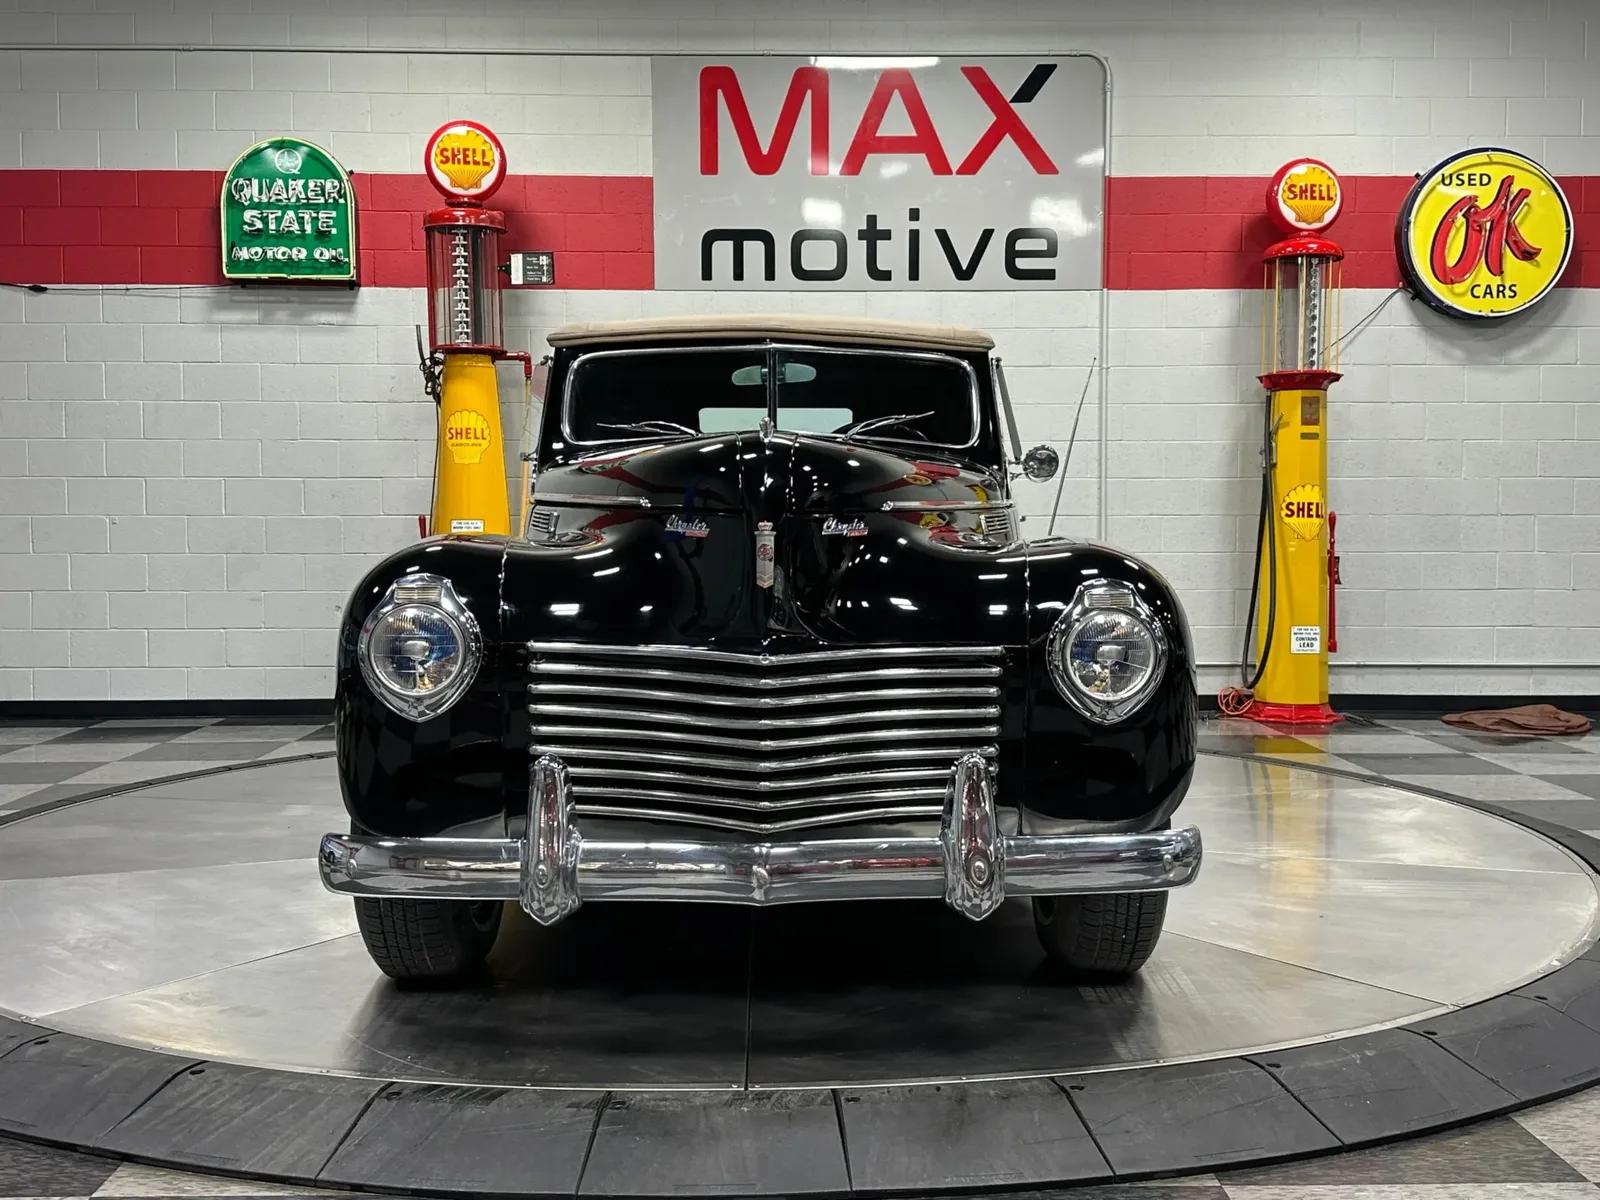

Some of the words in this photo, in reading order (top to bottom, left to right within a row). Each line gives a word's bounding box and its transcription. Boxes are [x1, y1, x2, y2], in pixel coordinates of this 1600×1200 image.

[699, 63, 1060, 176] MAX
[439, 147, 491, 167] SHELL
[1441, 173, 1492, 187] USED
[231, 177, 345, 206] QUAKER
[1286, 183, 1334, 201] SHELL
[243, 209, 337, 234] STATE
[1430, 175, 1542, 285] OK
[700, 207, 1059, 281] motive
[232, 246, 307, 262] MOTOR
[313, 246, 349, 262] OIL
[1470, 283, 1517, 299] CARS
[448, 427, 487, 440] SHELL
[1285, 502, 1323, 518] SHELL
